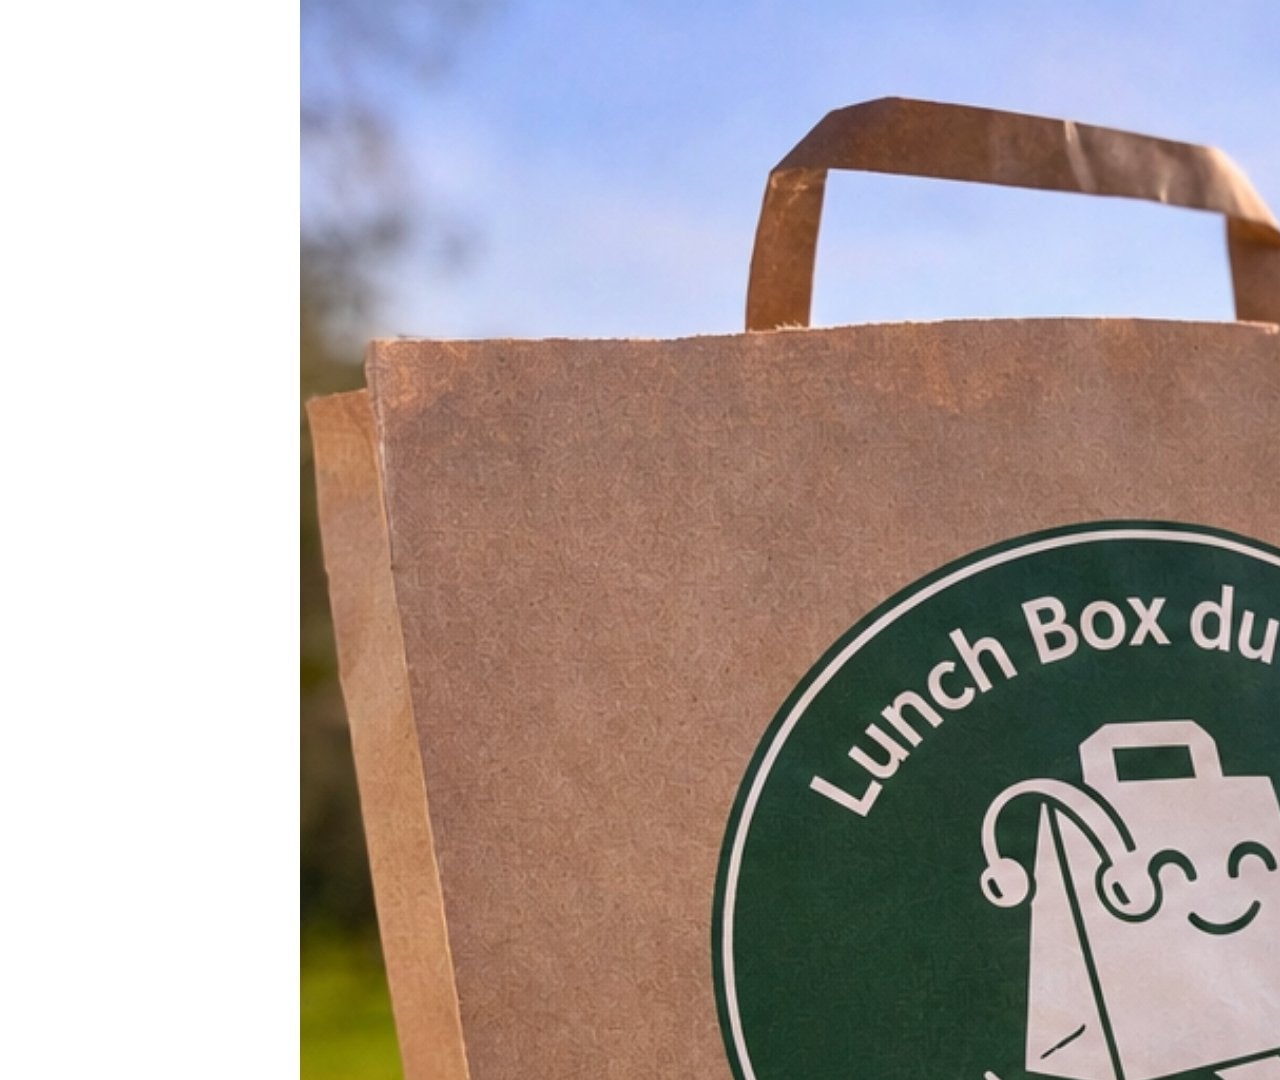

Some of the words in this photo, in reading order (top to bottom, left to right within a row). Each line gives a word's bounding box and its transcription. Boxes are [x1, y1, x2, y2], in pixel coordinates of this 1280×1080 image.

[810, 629, 1018, 816] Lunch
[1022, 596, 1170, 663] Box
[1191, 585, 1278, 663] du
